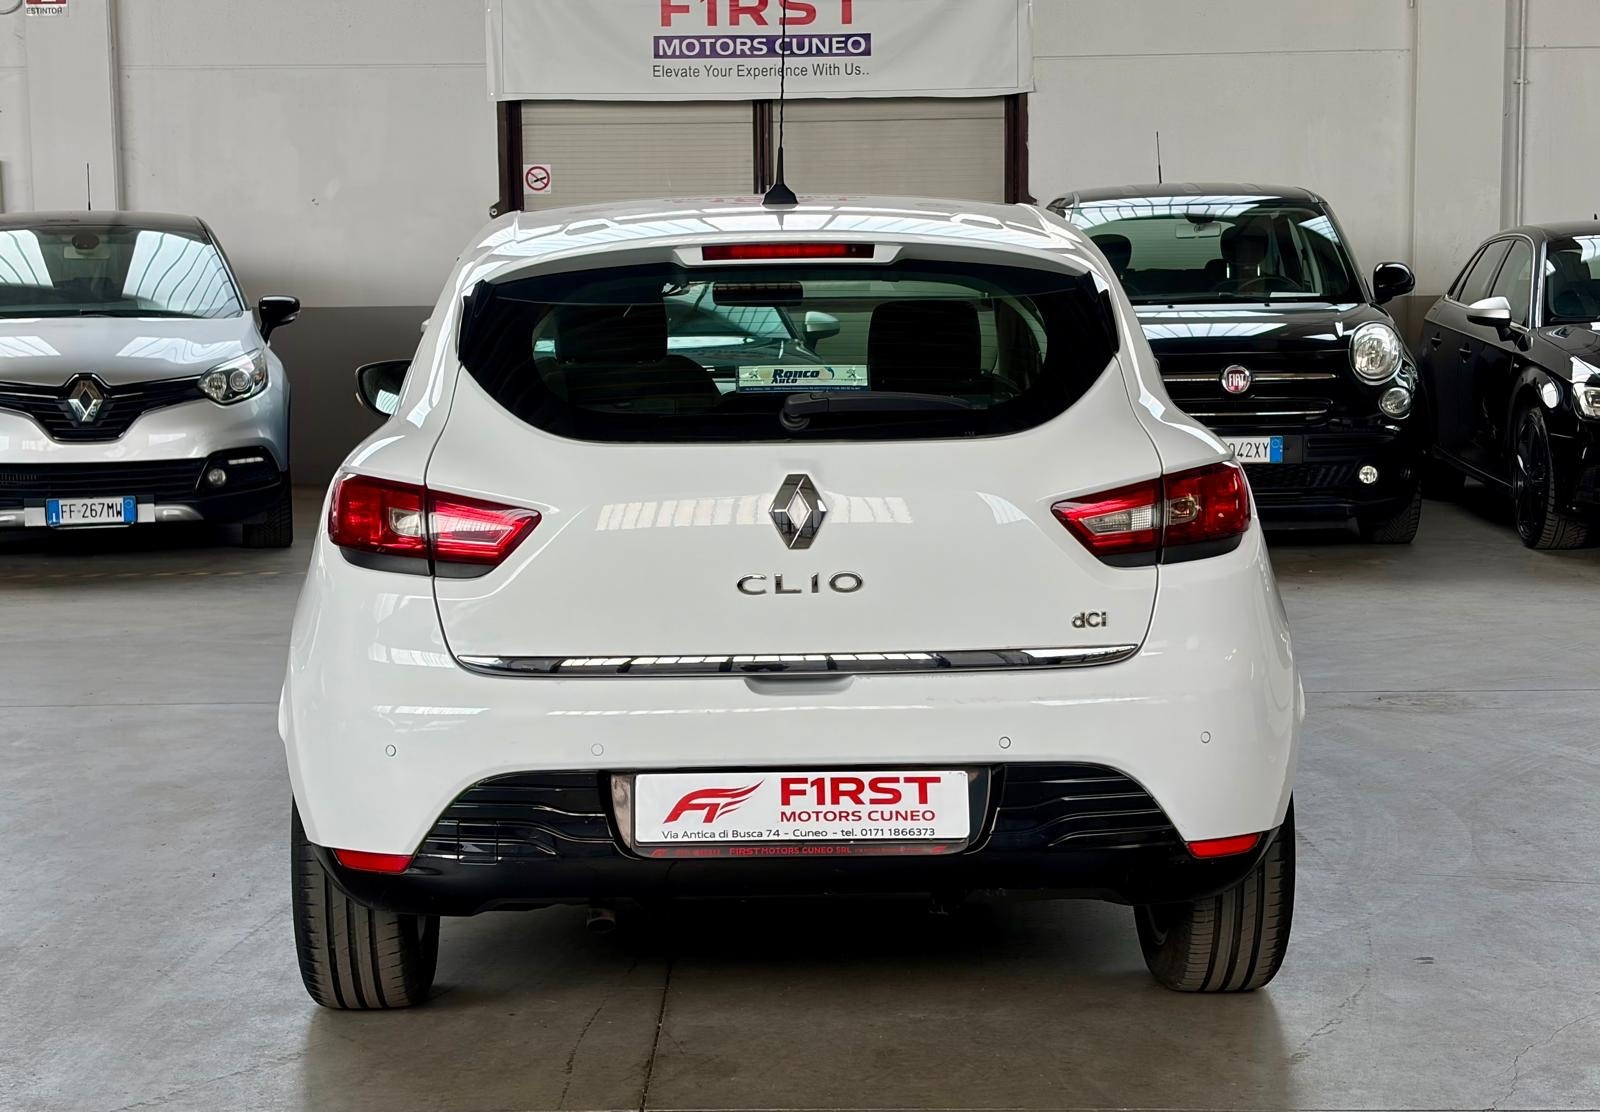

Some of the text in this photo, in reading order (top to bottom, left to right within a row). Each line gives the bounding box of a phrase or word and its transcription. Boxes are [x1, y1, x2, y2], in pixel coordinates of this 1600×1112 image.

[658, 36, 866, 56] MOTORS CUNEO
[652, 65, 700, 78] Elevate
[704, 65, 733, 78] Your
[737, 64, 808, 80] Experience
[812, 63, 840, 76] With
[772, 368, 820, 379] Ronco
[1228, 373, 1245, 387] FIAT
[60, 502, 123, 519] FF 267MW
[736, 571, 865, 596] CLIO
[1071, 611, 1108, 629] dCi
[780, 776, 942, 807] F1RST
[780, 809, 936, 823] MOTORS CUNEO
[662, 830, 679, 839] Via
[681, 829, 716, 839] Antica
[719, 829, 729, 838] di
[732, 829, 763, 838] Busca
[766, 829, 780, 838] 74
[793, 828, 828, 838] Cuneo
[841, 828, 857, 837] tel.
[860, 828, 884, 837] 0171
[888, 827, 936, 836] 1866373
